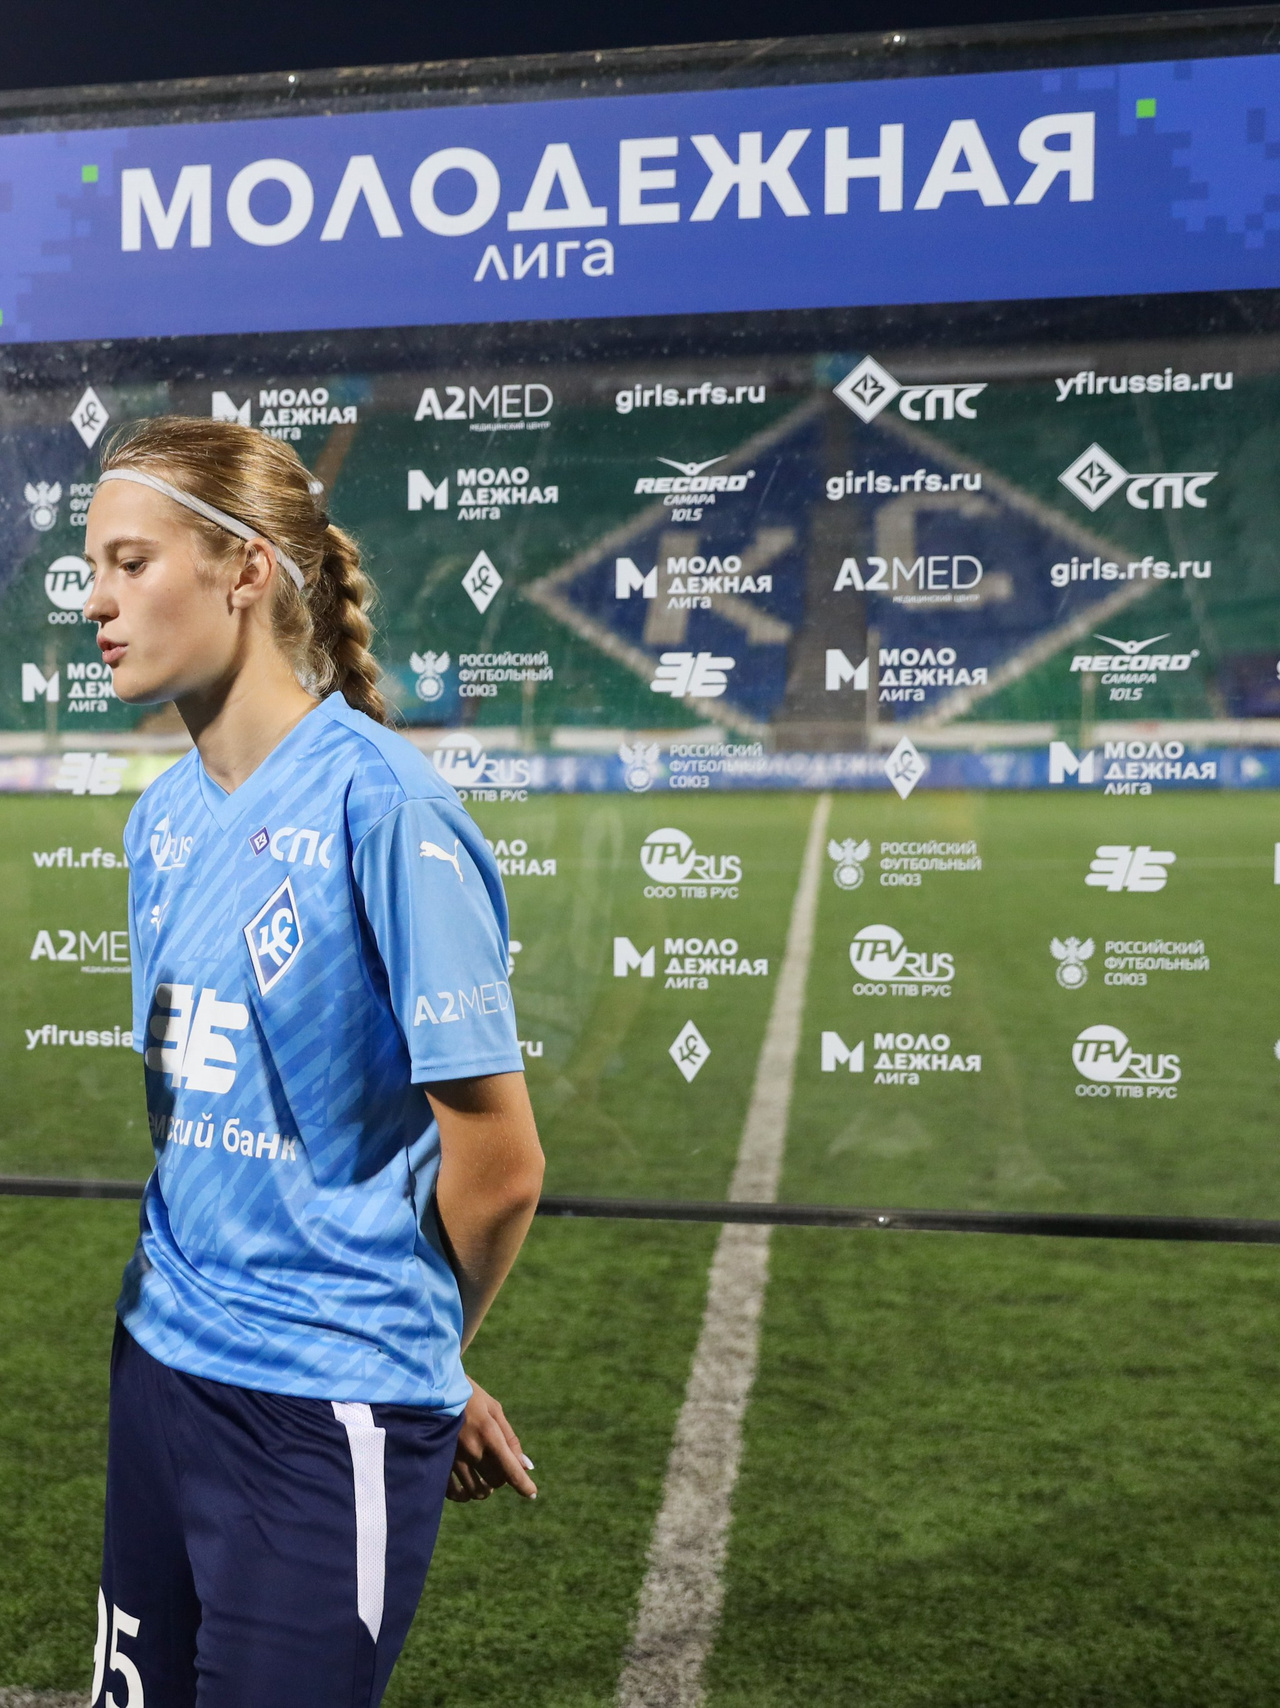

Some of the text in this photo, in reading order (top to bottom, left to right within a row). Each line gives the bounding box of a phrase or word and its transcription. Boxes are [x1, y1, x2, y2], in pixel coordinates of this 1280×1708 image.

[121, 110, 1096, 252] МОЛОДЕЖНАЯ
[473, 238, 616, 283] лига
[1055, 367, 1234, 402] yflrussia.ru
[259, 387, 330, 408] МОЛО
[413, 383, 554, 422] A2MED
[615, 382, 766, 414] girls.rfs.ru
[259, 406, 358, 427] ДЕЖНАЯ
[457, 466, 530, 486] МОЛО
[826, 468, 982, 500] girls.rfs.ru
[457, 485, 559, 506] ДЕЖНАЯ
[663, 493, 716, 506] САМАРА
[457, 505, 501, 521] лига
[666, 554, 743, 575] МОЛО
[833, 555, 984, 592] A2MED
[1051, 556, 1212, 587] girls.rfs.ru
[666, 574, 773, 594] ДЕЖНАЯ
[666, 594, 712, 610] лига
[458, 651, 549, 667] РОССИЙСКИЙ
[878, 647, 957, 667] МОЛО
[67, 661, 112, 680] МОЛ
[458, 667, 554, 683] ФУТБОЛЬНЫЙ
[878, 666, 988, 687] ДЕЖНАЯ
[1101, 673, 1157, 684] САМАРА
[67, 681, 117, 699] ДЕЖ
[458, 684, 498, 697] СОЮЗ
[878, 687, 926, 702] лига
[67, 699, 108, 713] лига
[1103, 740, 1185, 760] МОЛО
[1103, 760, 1217, 780] ДЕЖНАЯ
[470, 789, 497, 802] ТПВ
[500, 789, 529, 802] РУС
[1103, 781, 1153, 796] лига
[880, 839, 977, 856] РОССИЙСКИЙ
[880, 856, 982, 872] ФУТБОЛЬНЫЙ
[880, 873, 922, 886] СОЮЗ
[679, 885, 707, 899] ТПВ
[709, 885, 740, 899] РУС
[29, 929, 129, 962] A2ME
[663, 937, 739, 956] МОЛО
[1104, 939, 1205, 955] РОССИЙСКИЙ
[663, 957, 769, 976] ДЕЖНАЯ
[1104, 955, 1211, 971] ФУТБОЛЬНЫЙ
[663, 976, 709, 991] лига
[1104, 973, 1148, 986] СОЮЗ
[890, 983, 919, 997] ТПВ
[921, 983, 952, 997] РУС
[412, 980, 513, 1027] A2MED
[24, 1024, 134, 1051] yflrussia
[873, 1032, 952, 1052] МОЛО
[873, 1052, 983, 1073] ДЕЖНАЯ
[873, 1072, 920, 1085] лига
[1114, 1085, 1144, 1099] ТПВ
[1147, 1086, 1178, 1100] РУС
[222, 1118, 299, 1162] банк
[91, 1585, 145, 1708] 5
